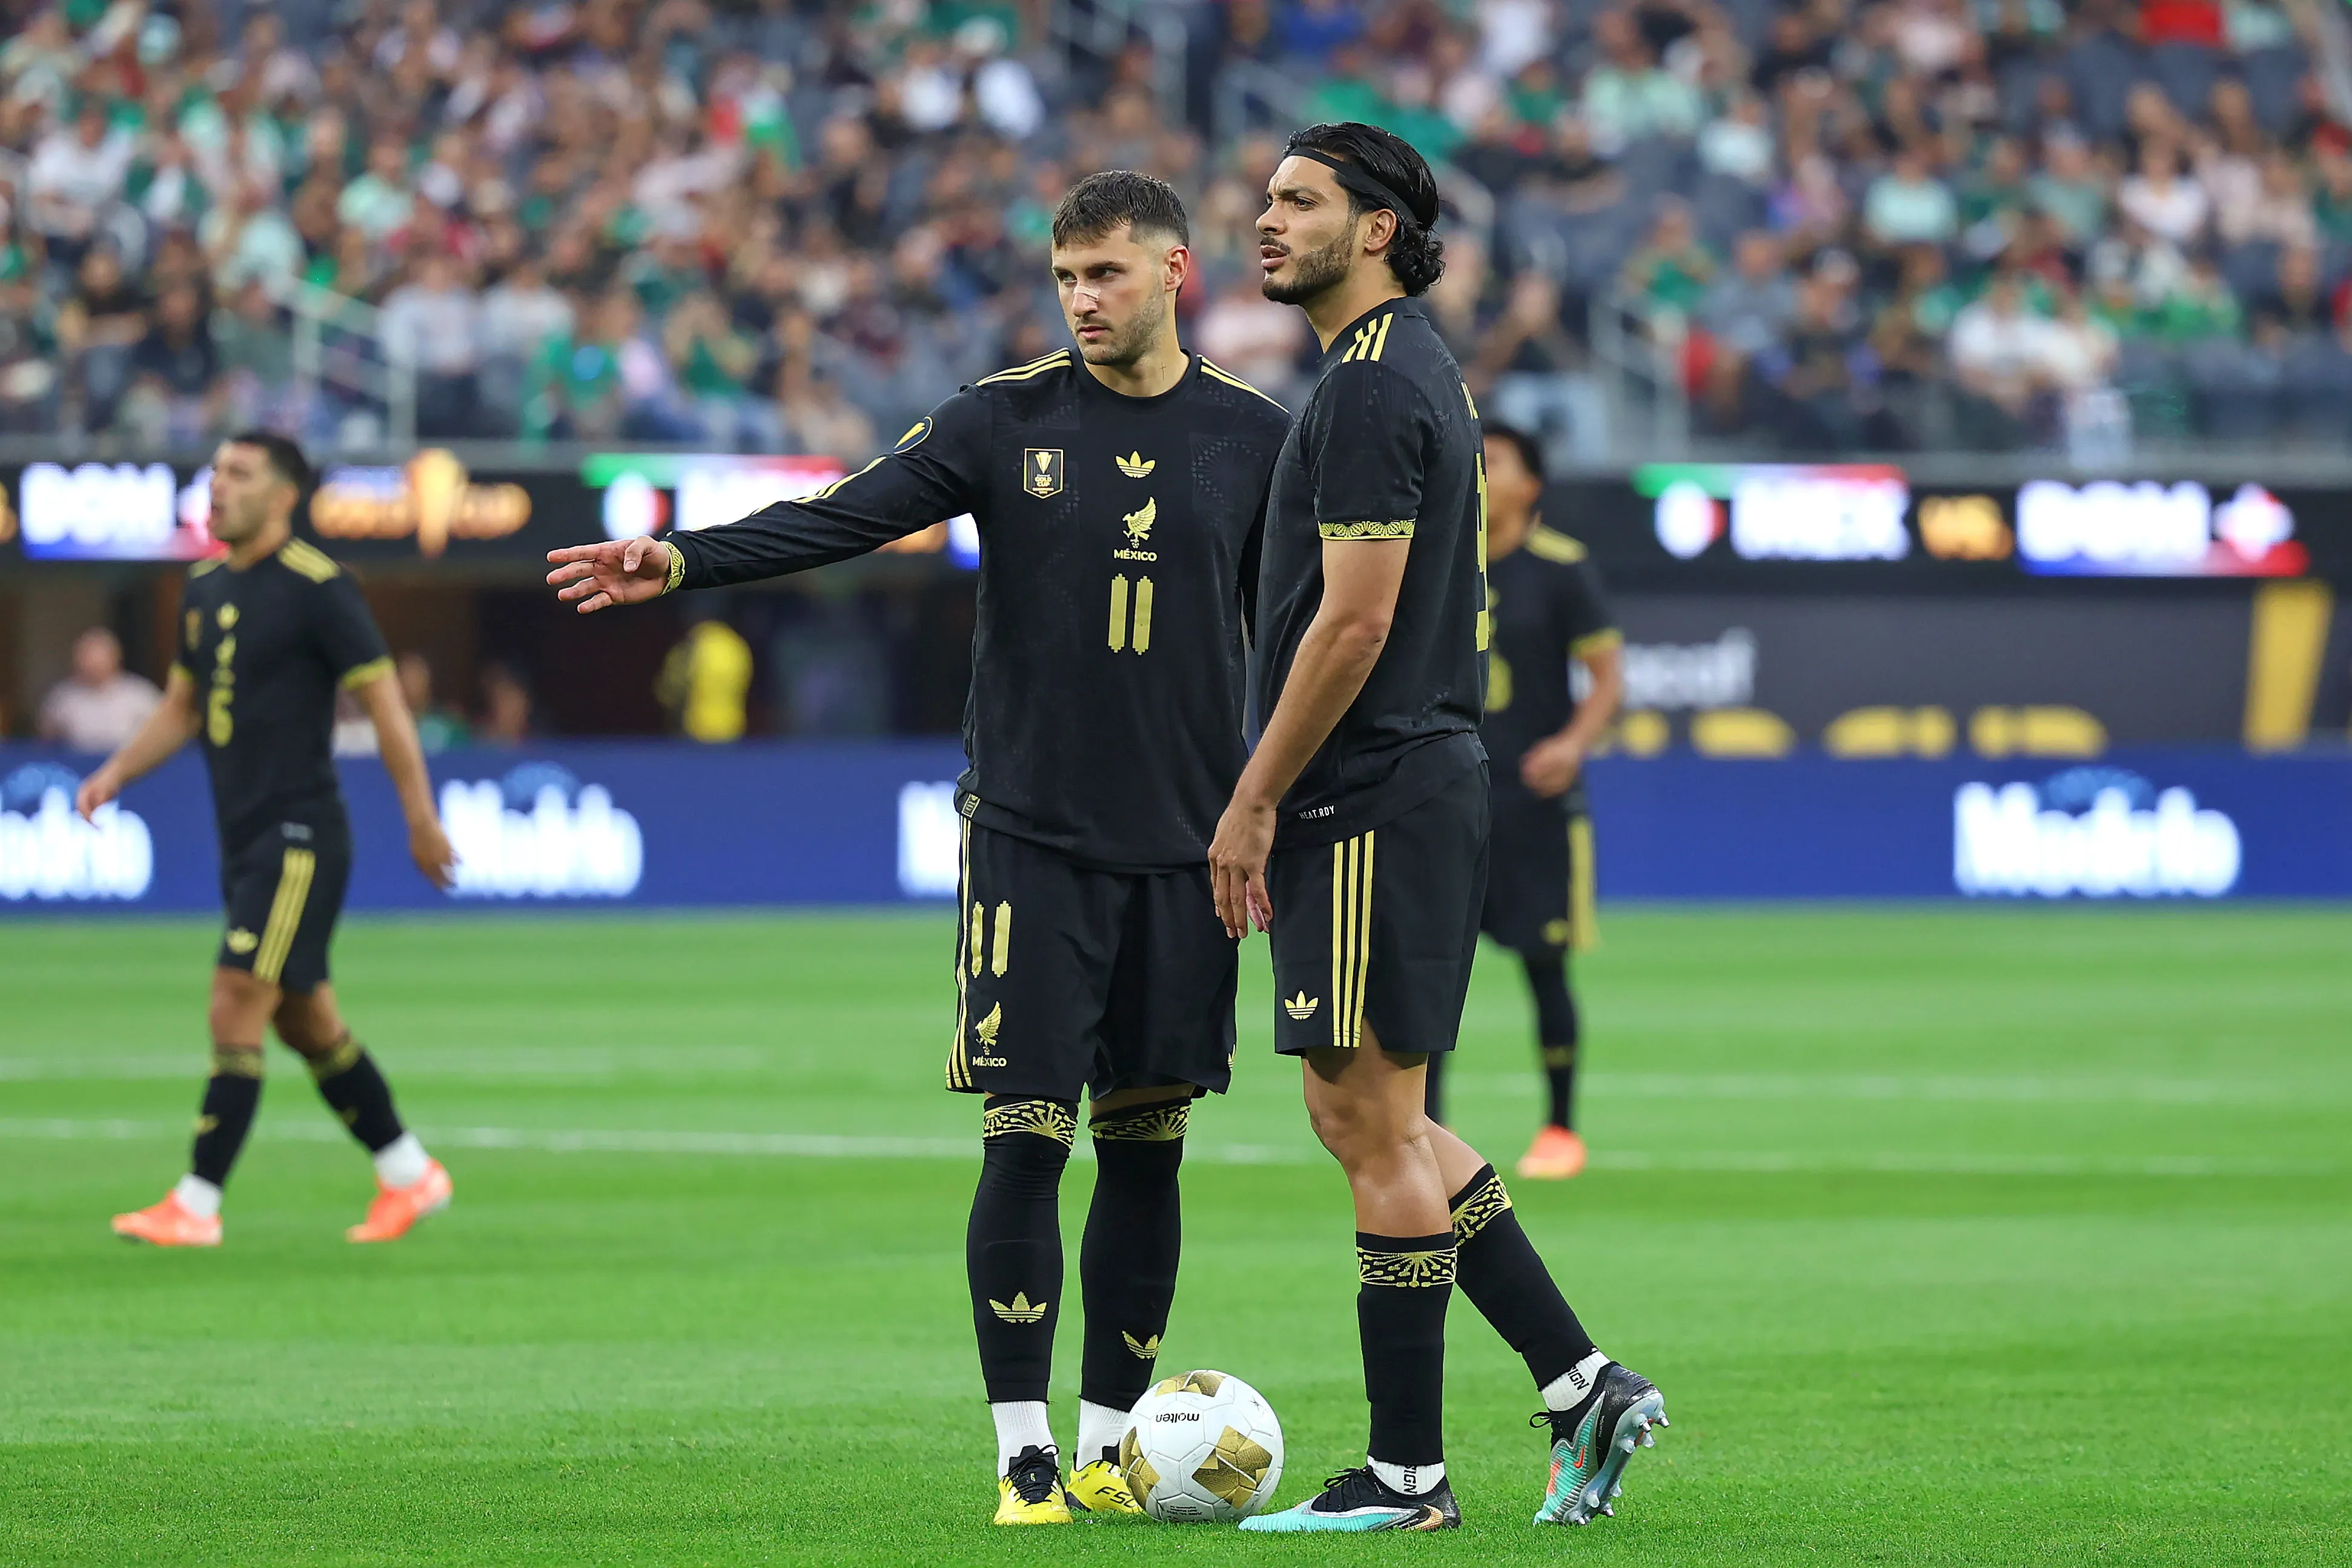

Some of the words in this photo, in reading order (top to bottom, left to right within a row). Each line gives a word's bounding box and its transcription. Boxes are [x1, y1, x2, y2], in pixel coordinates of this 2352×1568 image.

[1113, 548, 1158, 562] MÉXICO
[1108, 573, 1153, 655] 11
[1298, 805, 1334, 819] HEAT.RDY
[971, 900, 1012, 978] 11
[972, 1056, 1007, 1067] MÉXICO
[1155, 1412, 1200, 1423] molten
